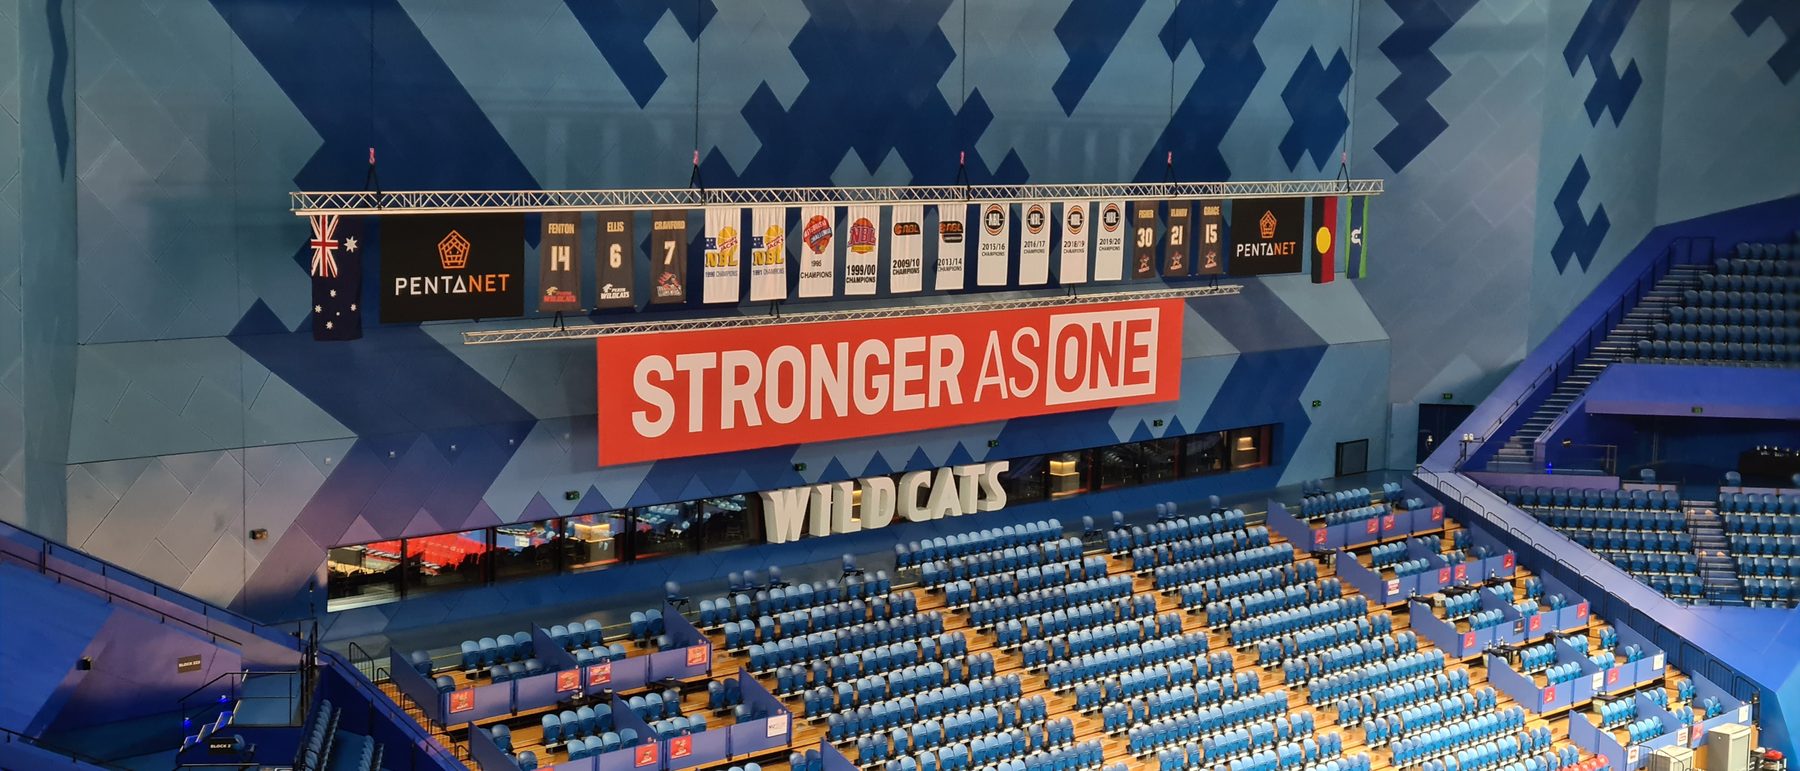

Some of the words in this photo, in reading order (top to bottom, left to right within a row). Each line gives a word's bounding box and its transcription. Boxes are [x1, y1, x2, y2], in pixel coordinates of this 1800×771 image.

[548, 223, 575, 234] FENTON
[607, 221, 625, 232] ELLIS
[1205, 223, 1218, 244] 15
[850, 226, 876, 245] NBL
[1137, 227, 1153, 248] 30
[1170, 225, 1183, 246] 21
[982, 243, 1005, 251] 2015/16
[1024, 240, 1046, 248] 2016/17
[1236, 241, 1296, 258] PENTANET
[551, 245, 570, 271] 14
[610, 243, 622, 268] 6
[664, 240, 676, 265] 7
[705, 251, 738, 267] NBL
[752, 250, 784, 266] NBL
[847, 264, 876, 276] 1999/00
[893, 259, 920, 268] 2009/10
[893, 267, 920, 275] CHAMPIONS
[800, 271, 832, 279] CHAMPIONS
[846, 276, 876, 284] CHAMPIONS
[395, 274, 510, 296] PENTANET
[600, 291, 630, 299] WILDCATS
[631, 333, 965, 439] STRONGER
[973, 326, 1041, 403] AS
[1054, 318, 1153, 392] ONE
[758, 460, 1010, 544] WILDCATS
